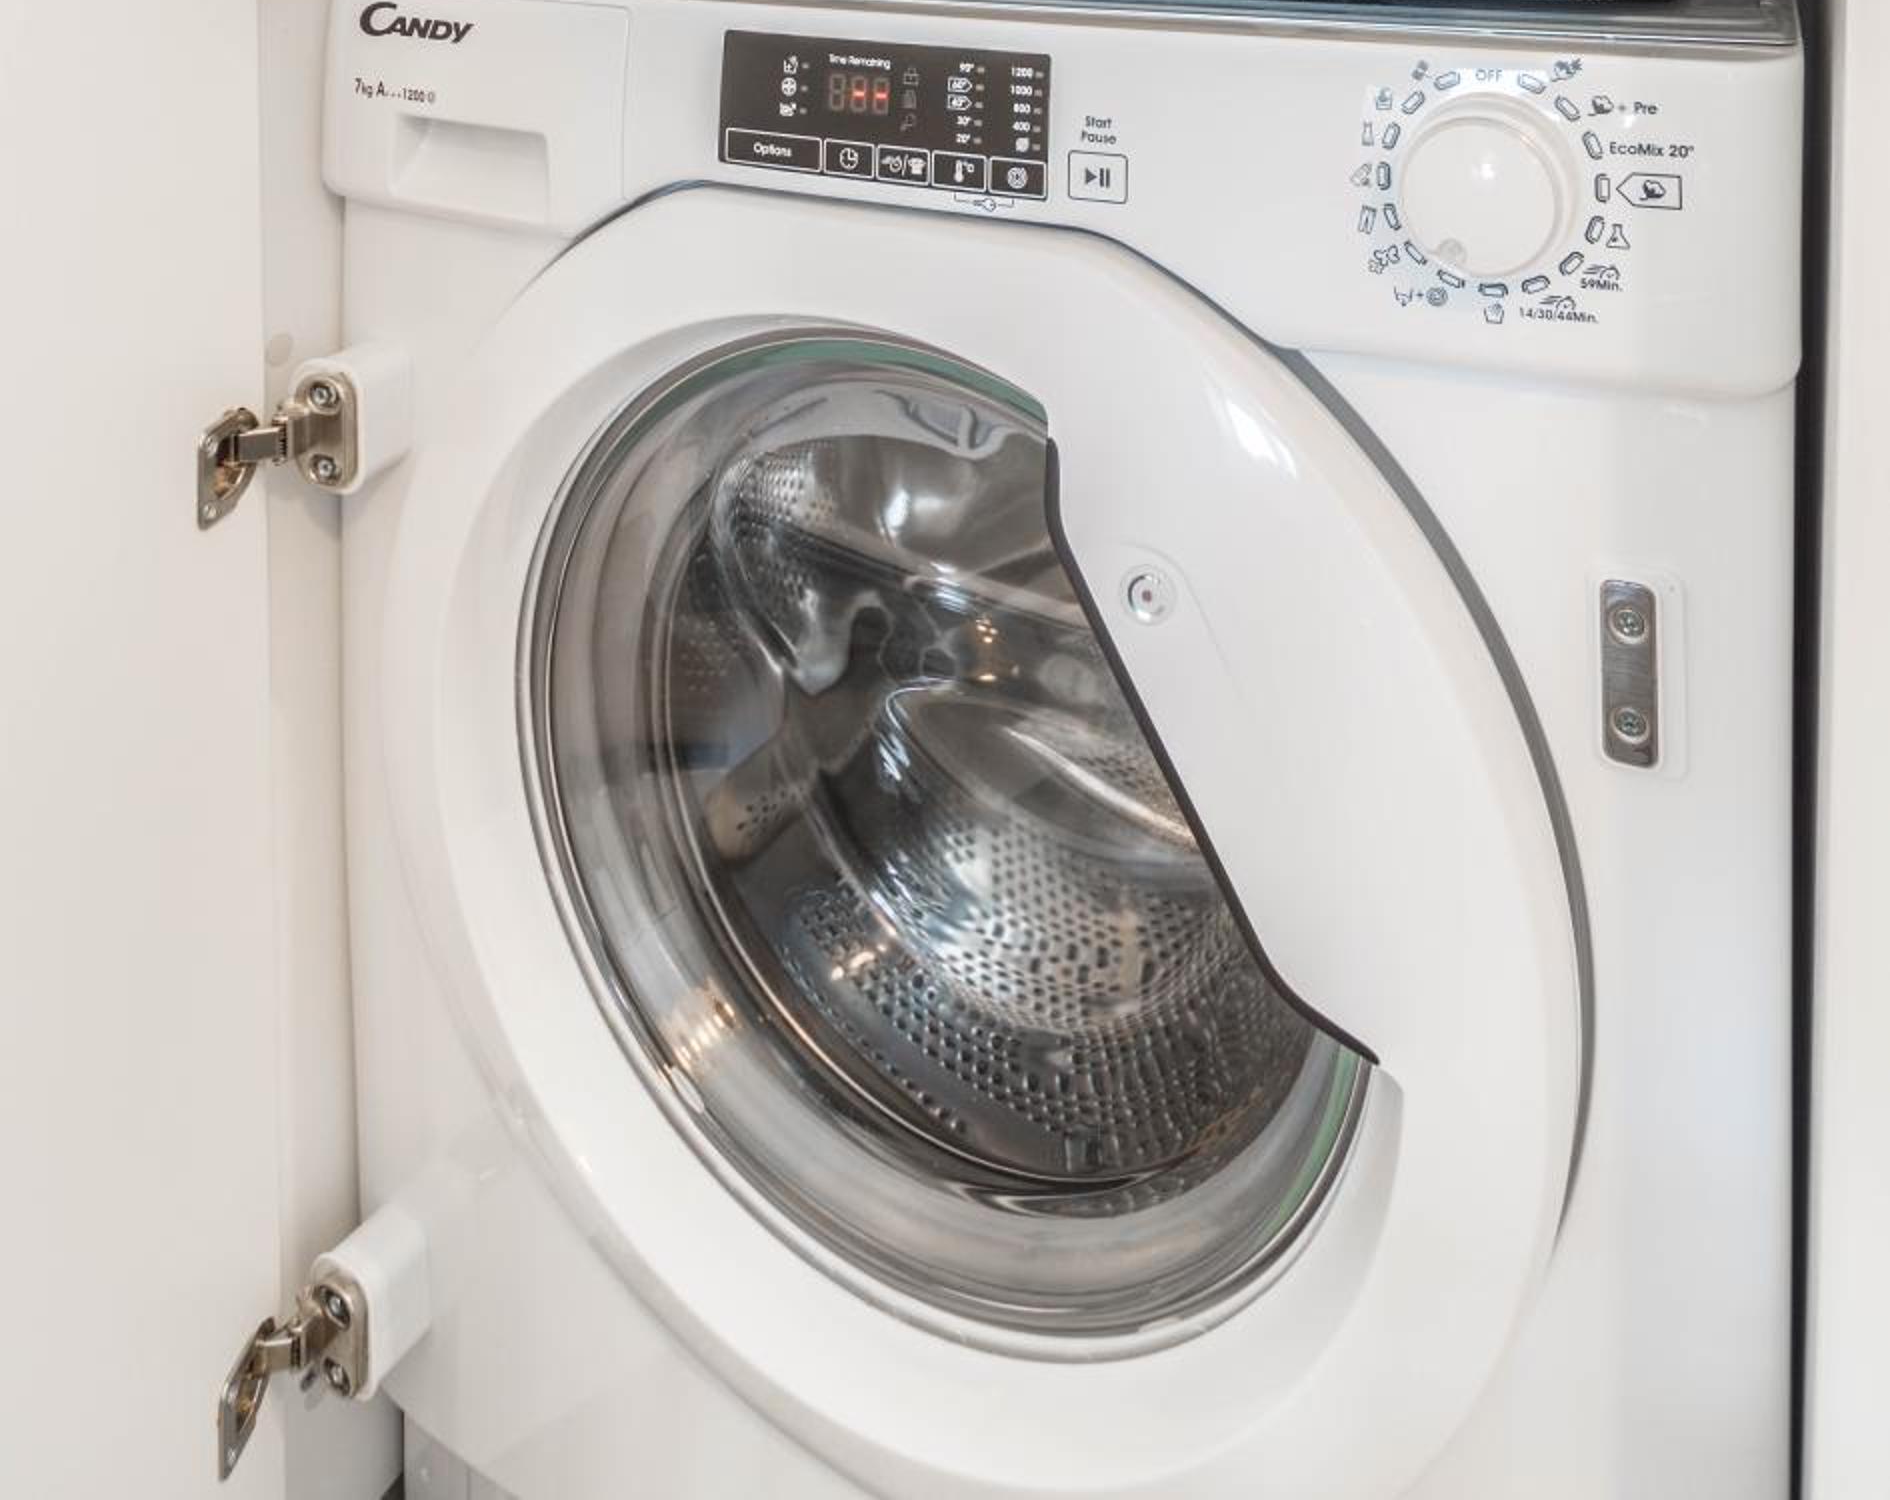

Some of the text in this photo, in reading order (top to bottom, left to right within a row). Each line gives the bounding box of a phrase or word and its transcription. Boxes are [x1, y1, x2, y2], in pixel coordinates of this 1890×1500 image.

[359, 1, 475, 44] CANDY
[848, 55, 891, 71] Remaining
[1011, 66, 1034, 79] 1200
[1475, 69, 1504, 82] OFF
[1010, 84, 1033, 96] 1000
[1013, 103, 1031, 114] 800
[1633, 102, 1658, 115] Pre
[1012, 121, 1031, 132] 400
[1085, 115, 1112, 129] Start
[1081, 131, 1117, 144] Pause
[753, 141, 793, 157] Options
[1609, 141, 1695, 159] EcoMix 20°
[1579, 277, 1623, 291] 59Min.
[1519, 306, 1600, 323] 14/30/44Min.
